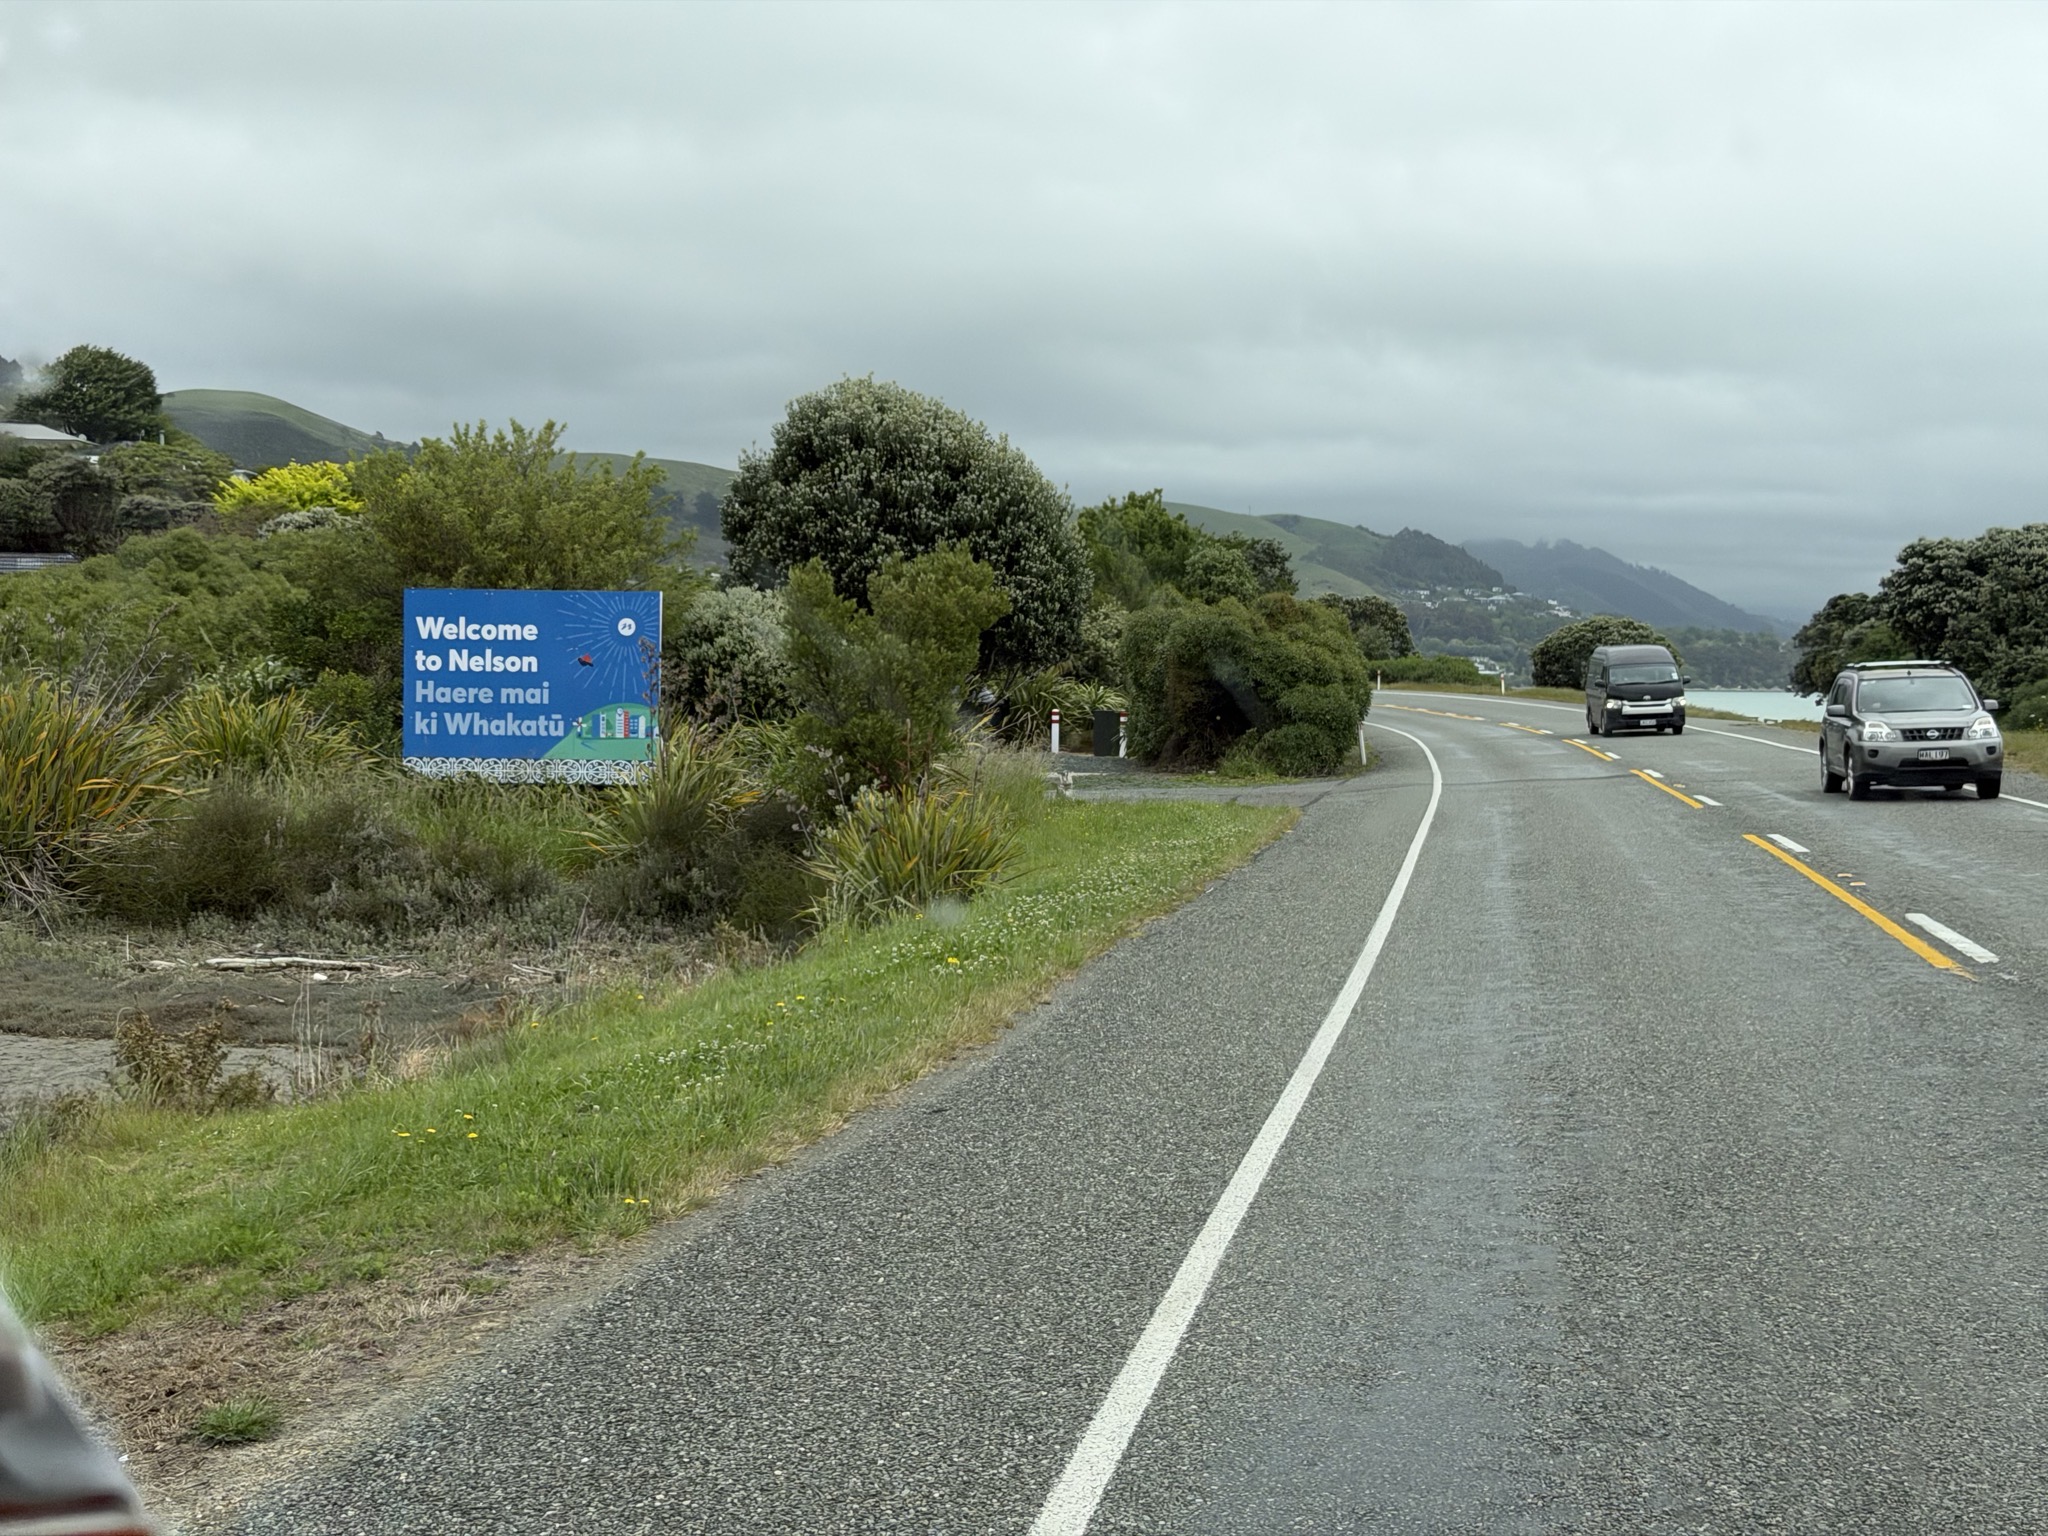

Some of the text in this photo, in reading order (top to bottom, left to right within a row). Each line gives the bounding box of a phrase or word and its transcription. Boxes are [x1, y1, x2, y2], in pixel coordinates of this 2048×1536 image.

[415, 616, 538, 641] Welcome
[415, 648, 538, 672] to Nelson
[415, 680, 549, 705] Haere mai
[414, 711, 565, 737] ki Whakatū
